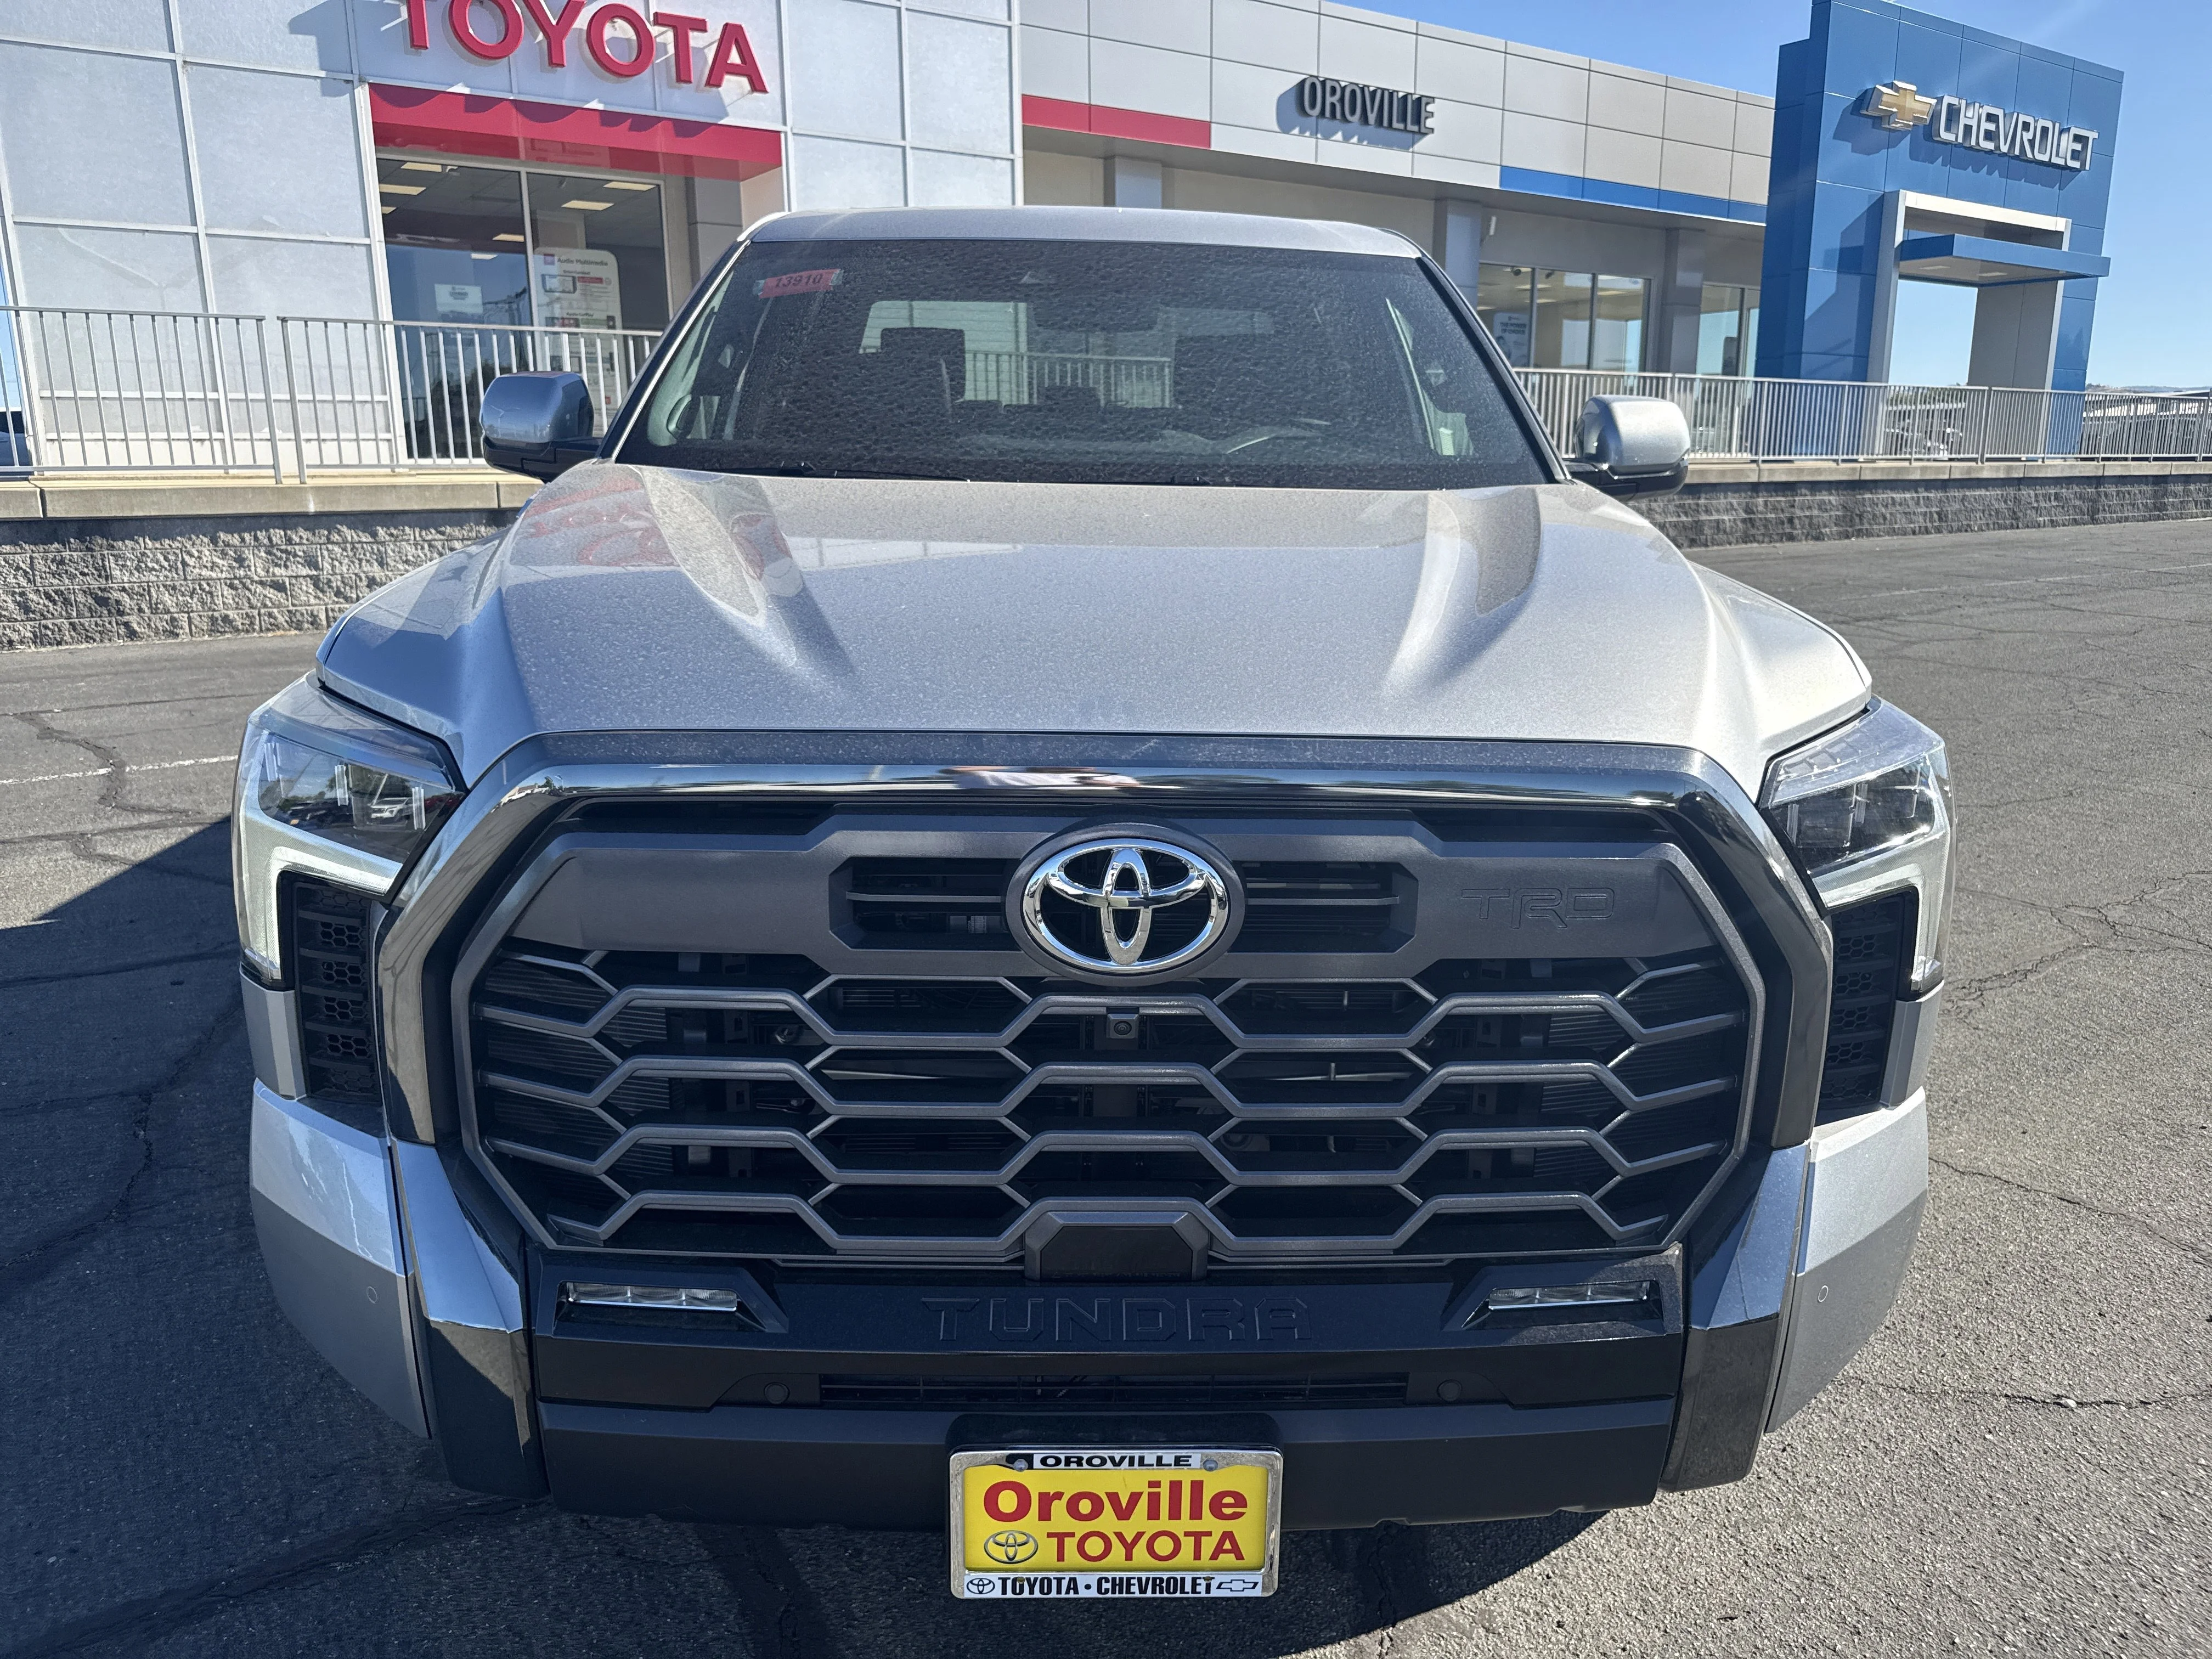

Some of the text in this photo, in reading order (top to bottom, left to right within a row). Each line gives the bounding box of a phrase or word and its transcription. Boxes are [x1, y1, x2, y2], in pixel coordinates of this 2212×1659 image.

[1303, 76, 1435, 134] OROVILLE
[1933, 94, 2100, 171] CHEVROLET
[775, 274, 822, 287] 13910
[1460, 887, 1615, 929] TRD
[921, 1297, 1312, 1341] TUNDRA
[1040, 1455, 1192, 1468] OROVILLE
[983, 1480, 1248, 1522] Oroville
[1047, 1530, 1245, 1562] TOYOTA
[998, 1576, 1215, 1595] TOYOTA CHEVROLET
